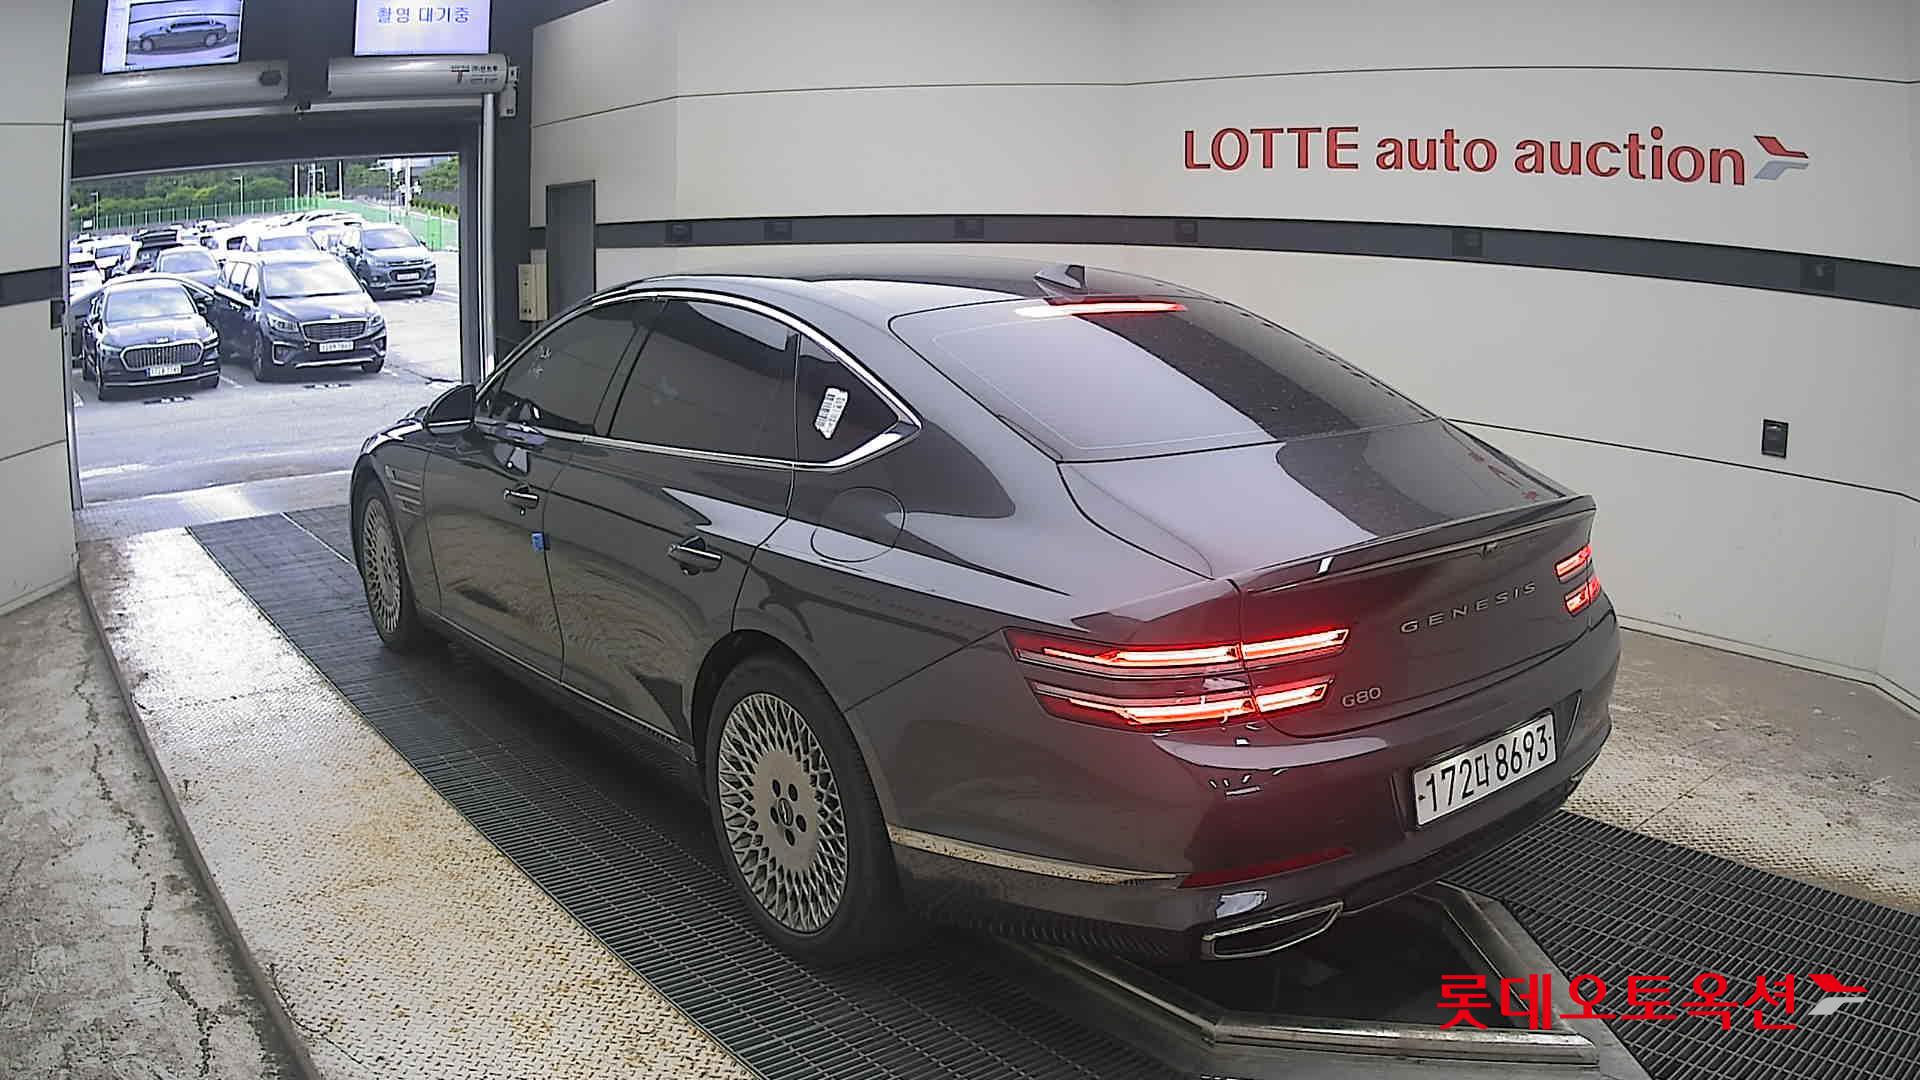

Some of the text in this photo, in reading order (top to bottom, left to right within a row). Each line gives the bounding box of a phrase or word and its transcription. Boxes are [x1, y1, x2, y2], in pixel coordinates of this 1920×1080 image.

[1184, 125, 1746, 186] LOTTE auto auction
[1400, 582, 1537, 633] GENESIS
[1342, 687, 1382, 708] G80
[1425, 724, 1549, 812] 172다 8693
